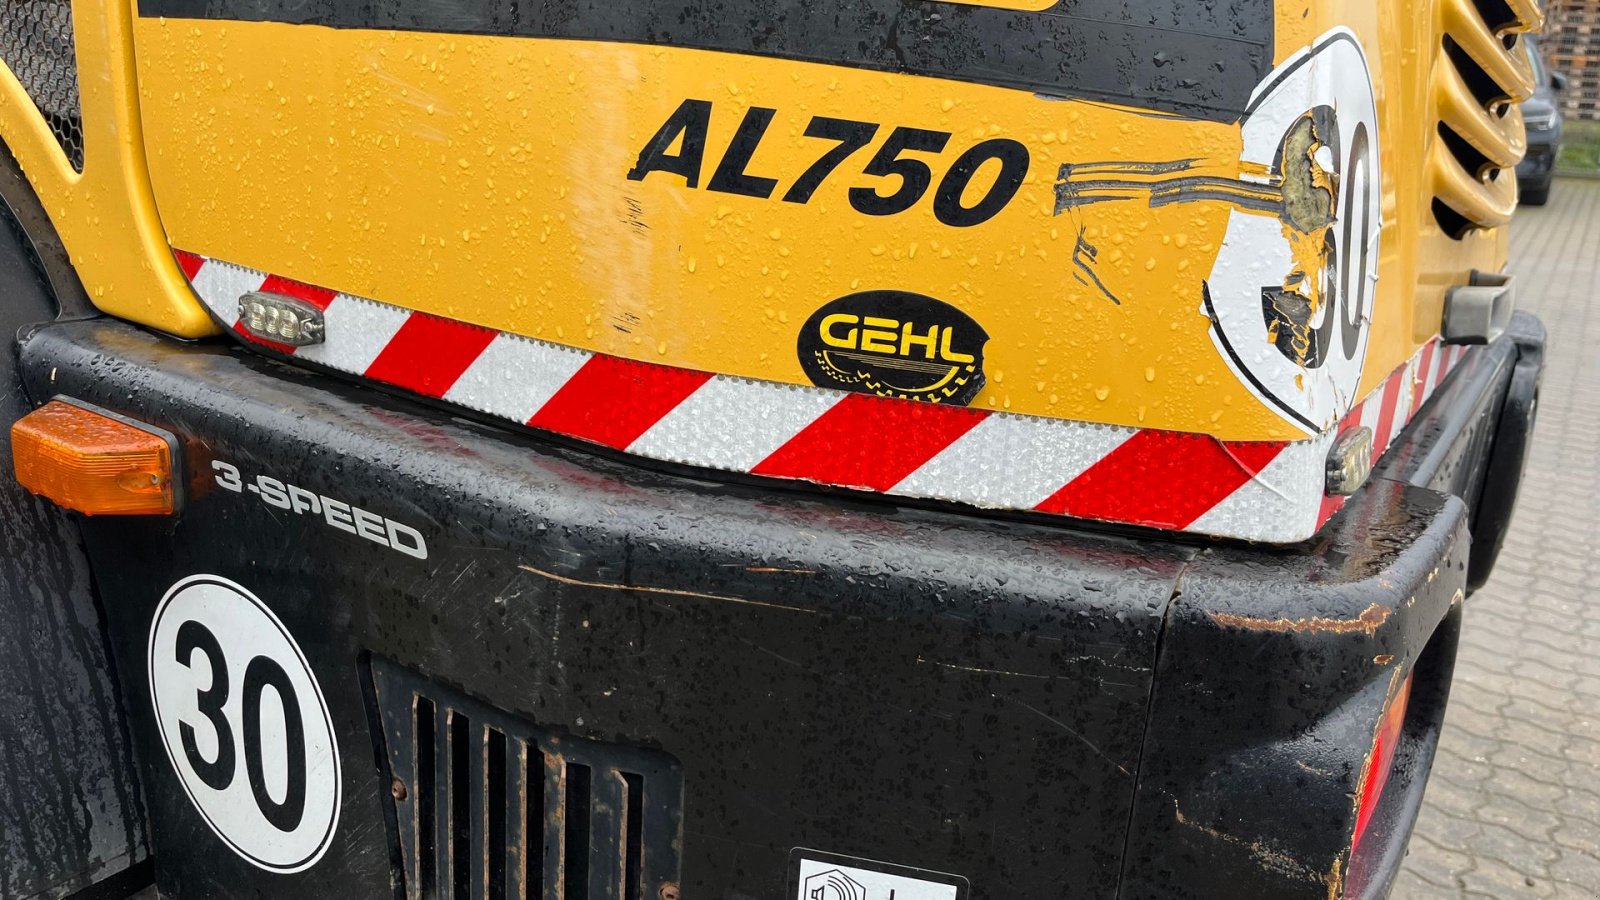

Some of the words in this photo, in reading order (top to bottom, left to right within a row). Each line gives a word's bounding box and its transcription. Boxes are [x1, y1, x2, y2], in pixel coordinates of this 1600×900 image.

[627, 98, 1030, 227] AL750
[819, 313, 975, 363] GEHL
[211, 460, 428, 560] 3-SPEED
[175, 620, 306, 833] 30
